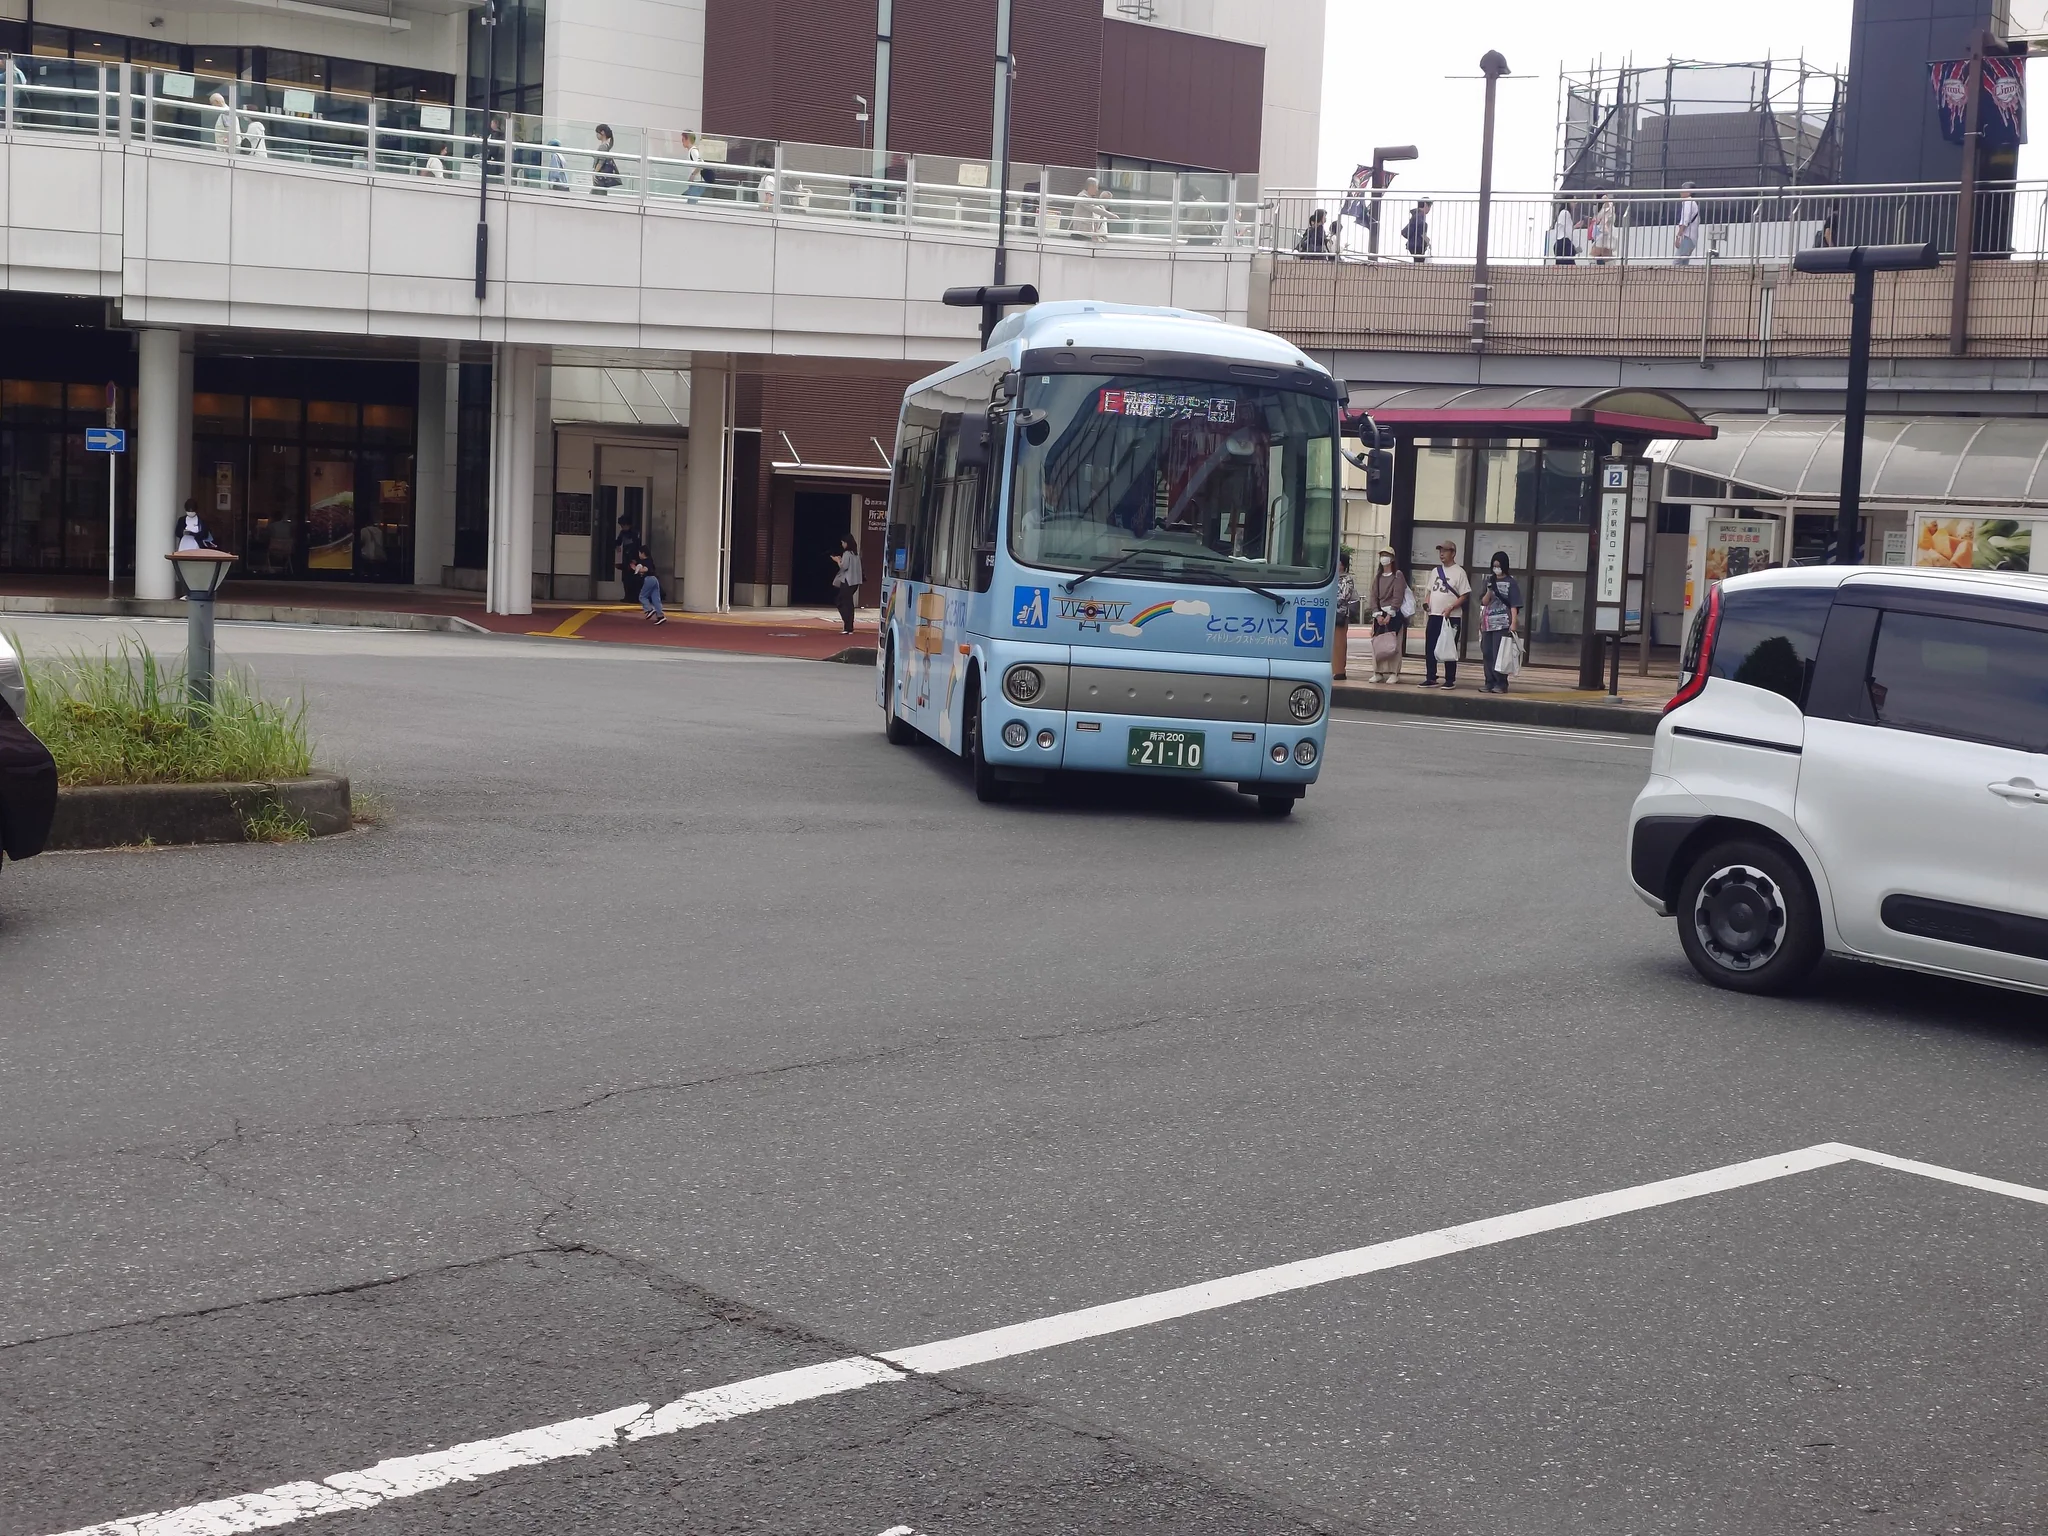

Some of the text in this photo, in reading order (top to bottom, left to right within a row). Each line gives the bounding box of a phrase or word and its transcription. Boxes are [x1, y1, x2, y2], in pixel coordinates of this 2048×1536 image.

[1104, 392, 1120, 412] E
[1612, 473, 1620, 485] 2
[1293, 597, 1330, 607] A6-996
[1206, 615, 1289, 635] ところバス
[1131, 741, 1201, 767] か 21-10
